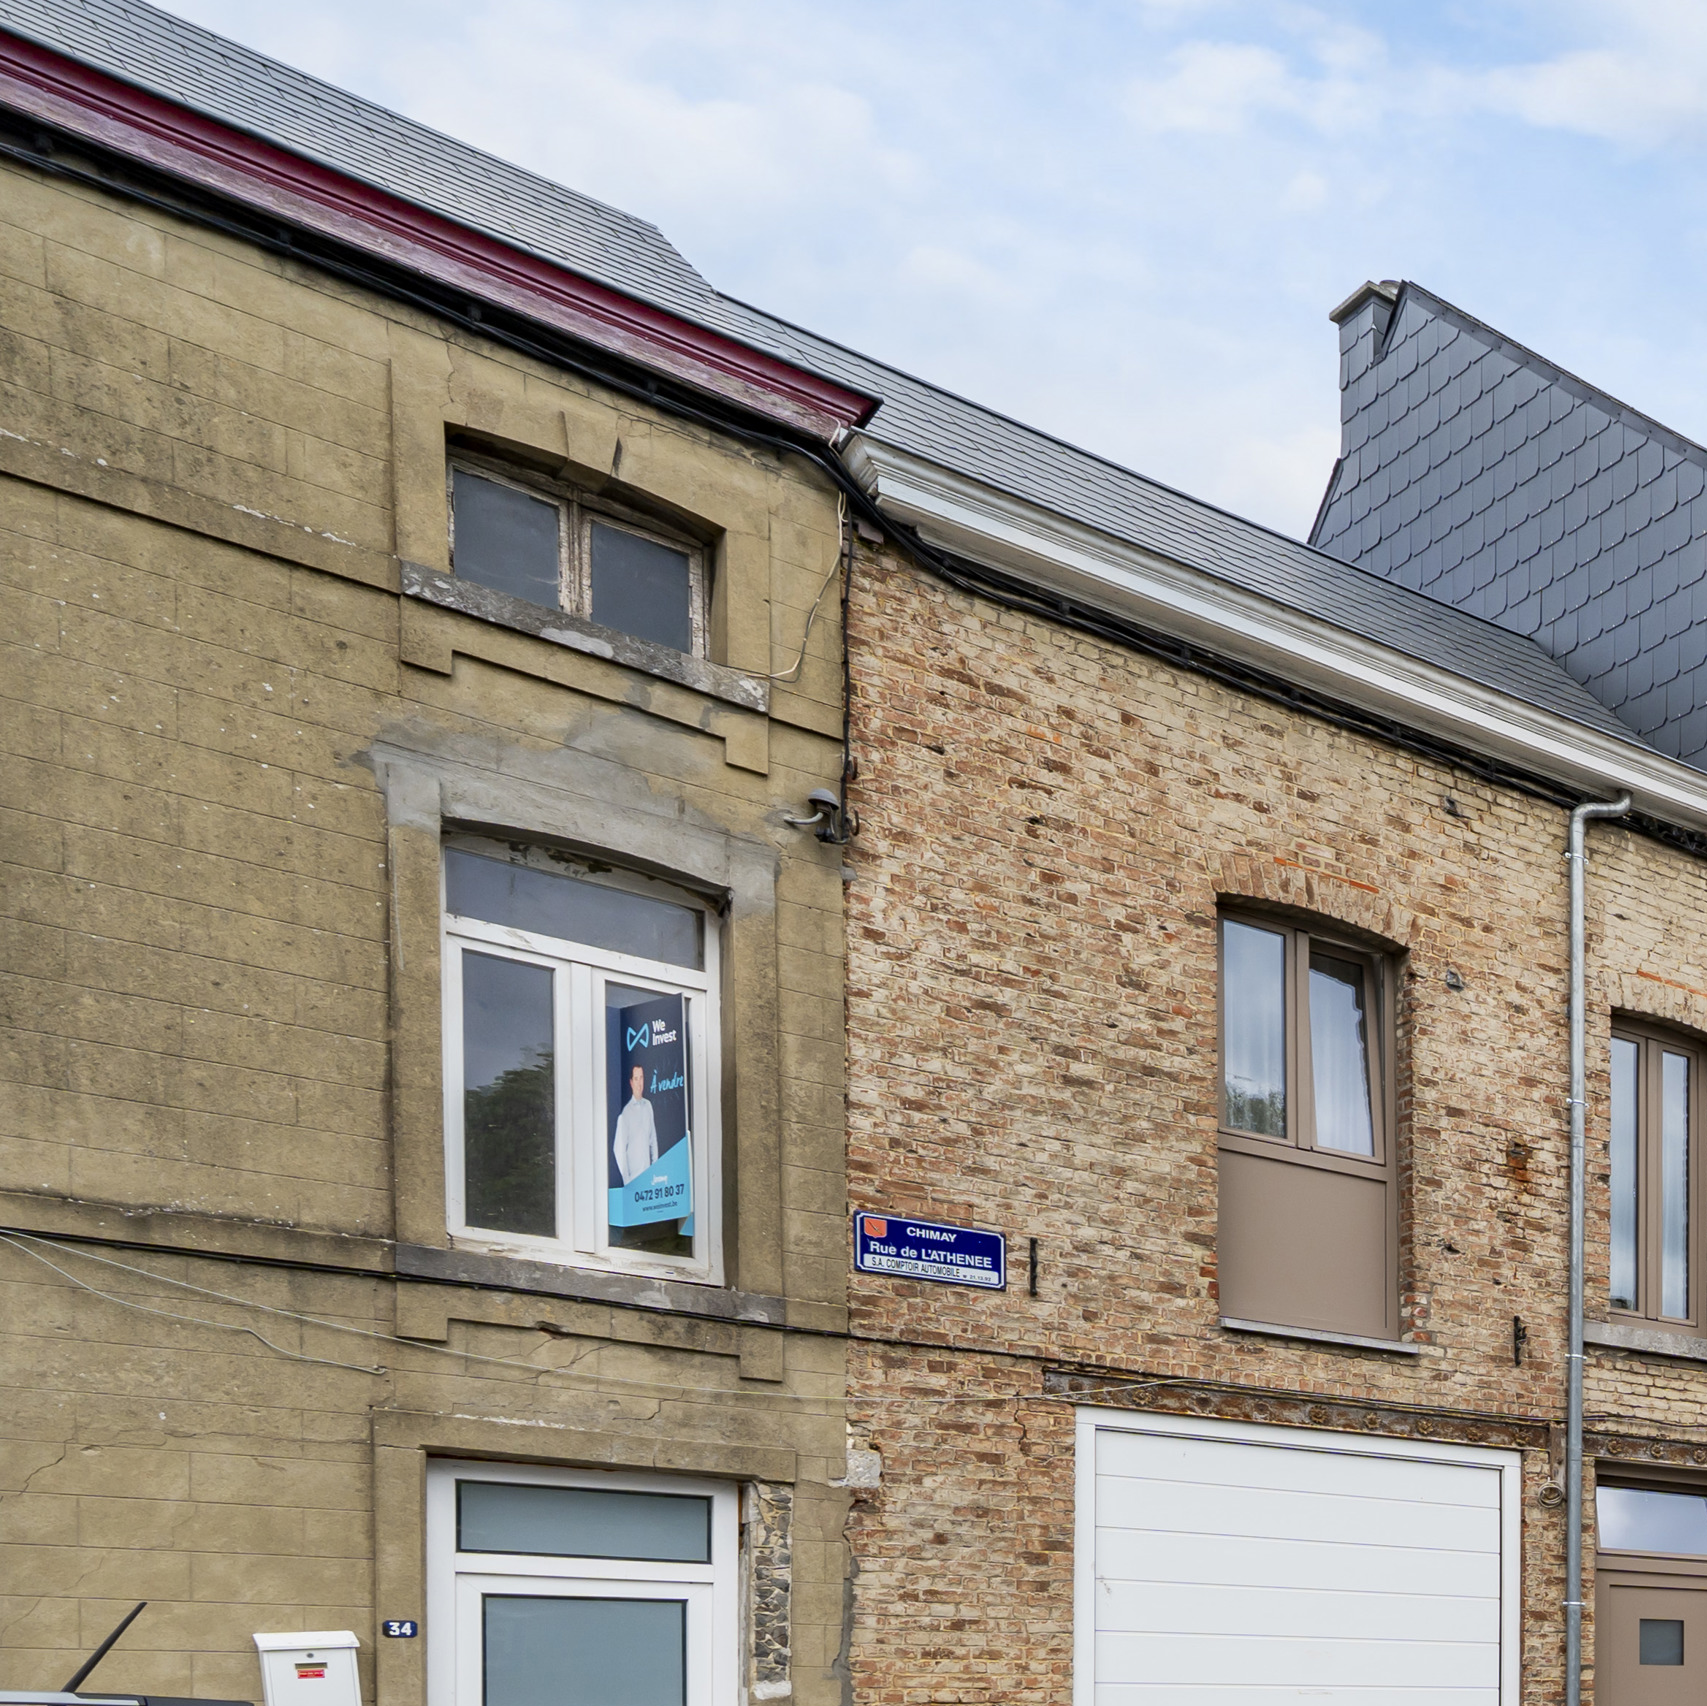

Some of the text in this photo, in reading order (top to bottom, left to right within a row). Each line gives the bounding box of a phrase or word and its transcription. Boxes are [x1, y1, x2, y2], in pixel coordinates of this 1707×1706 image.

[652, 1019, 666, 1033] We
[652, 1030, 677, 1047] Invest
[658, 1071, 684, 1092] vendre
[634, 1183, 685, 1203] 0472 91 80 37
[906, 1226, 957, 1243] CHIMAY
[869, 1241, 993, 1269] Rue de L'ATHENEE
[872, 1256, 885, 1268] S.A.
[886, 1258, 919, 1272] COMPTOIR
[921, 1262, 961, 1278] AUTOMOBILE
[388, 1622, 412, 1636] 34
